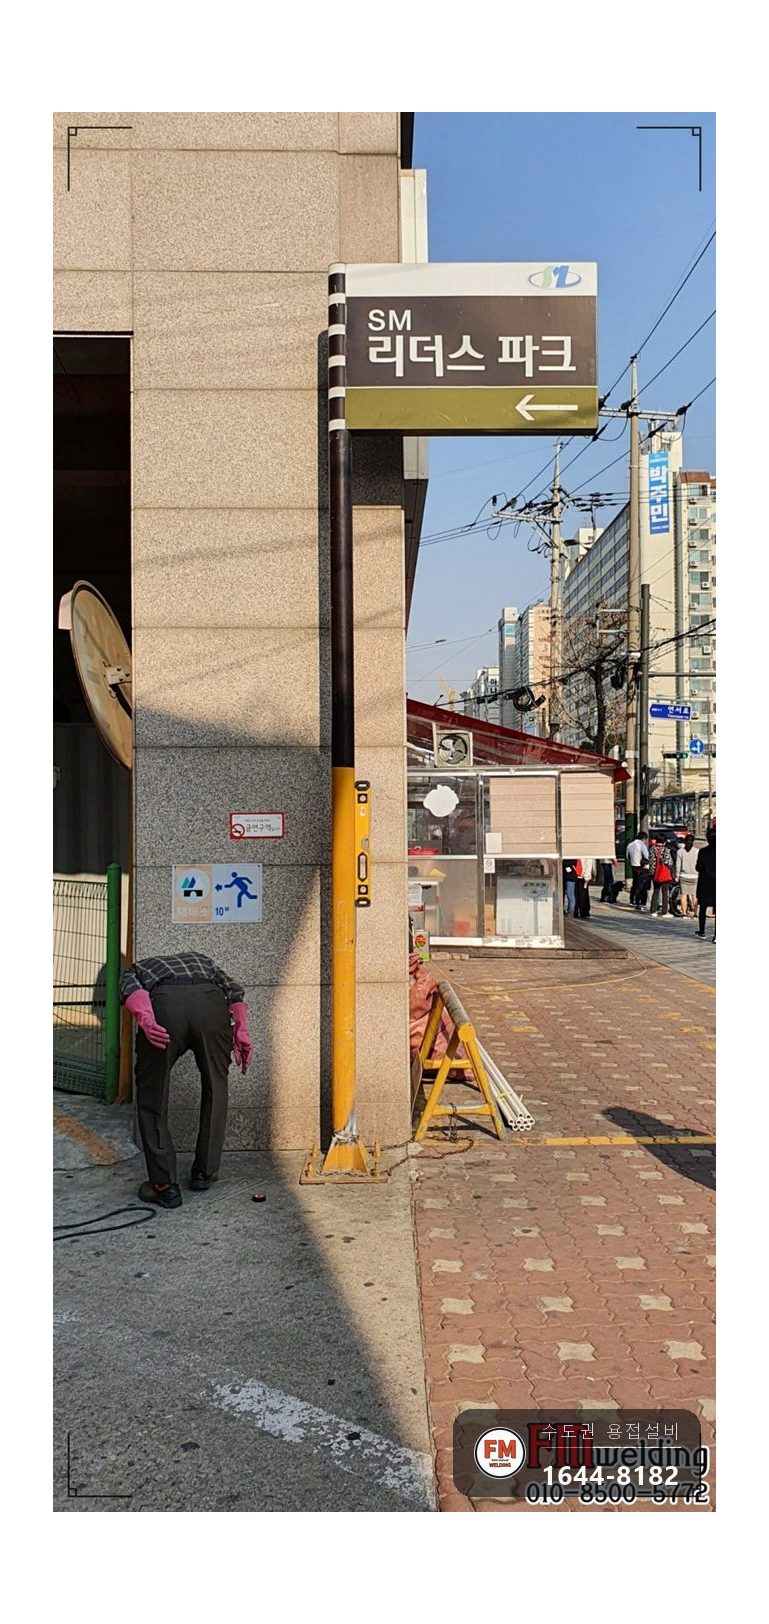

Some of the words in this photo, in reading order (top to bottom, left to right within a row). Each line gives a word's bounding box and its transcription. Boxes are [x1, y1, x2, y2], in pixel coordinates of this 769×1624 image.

[367, 309, 411, 331] SM
[367, 334, 486, 377] 리더스
[498, 334, 577, 377] 파크
